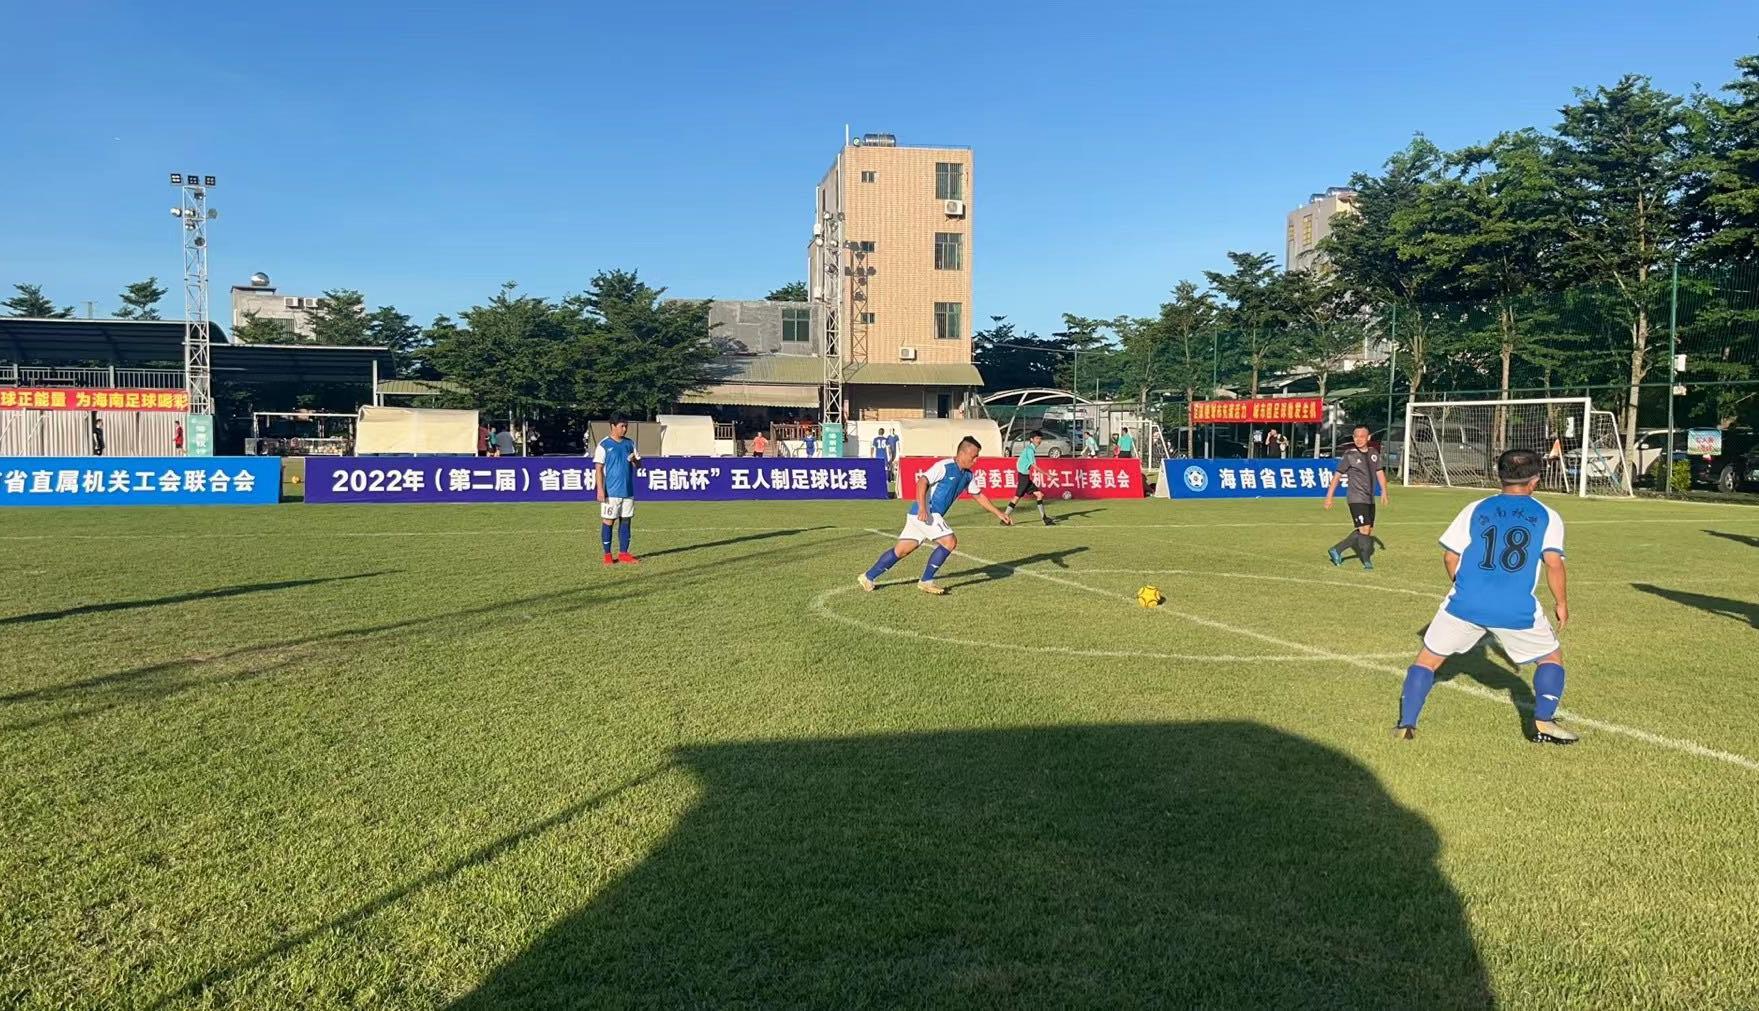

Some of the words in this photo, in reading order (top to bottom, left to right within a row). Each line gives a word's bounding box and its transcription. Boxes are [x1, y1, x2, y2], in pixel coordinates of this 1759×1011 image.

[1, 391, 66, 407] 球正能量
[76, 391, 189, 410] 为海南足球喝彩
[0, 469, 255, 493] 省直属机关工会联合会
[332, 468, 867, 492] 2022年（第二届）省直机“启航杯”五人制足球比赛
[1478, 525, 1531, 573] 18
